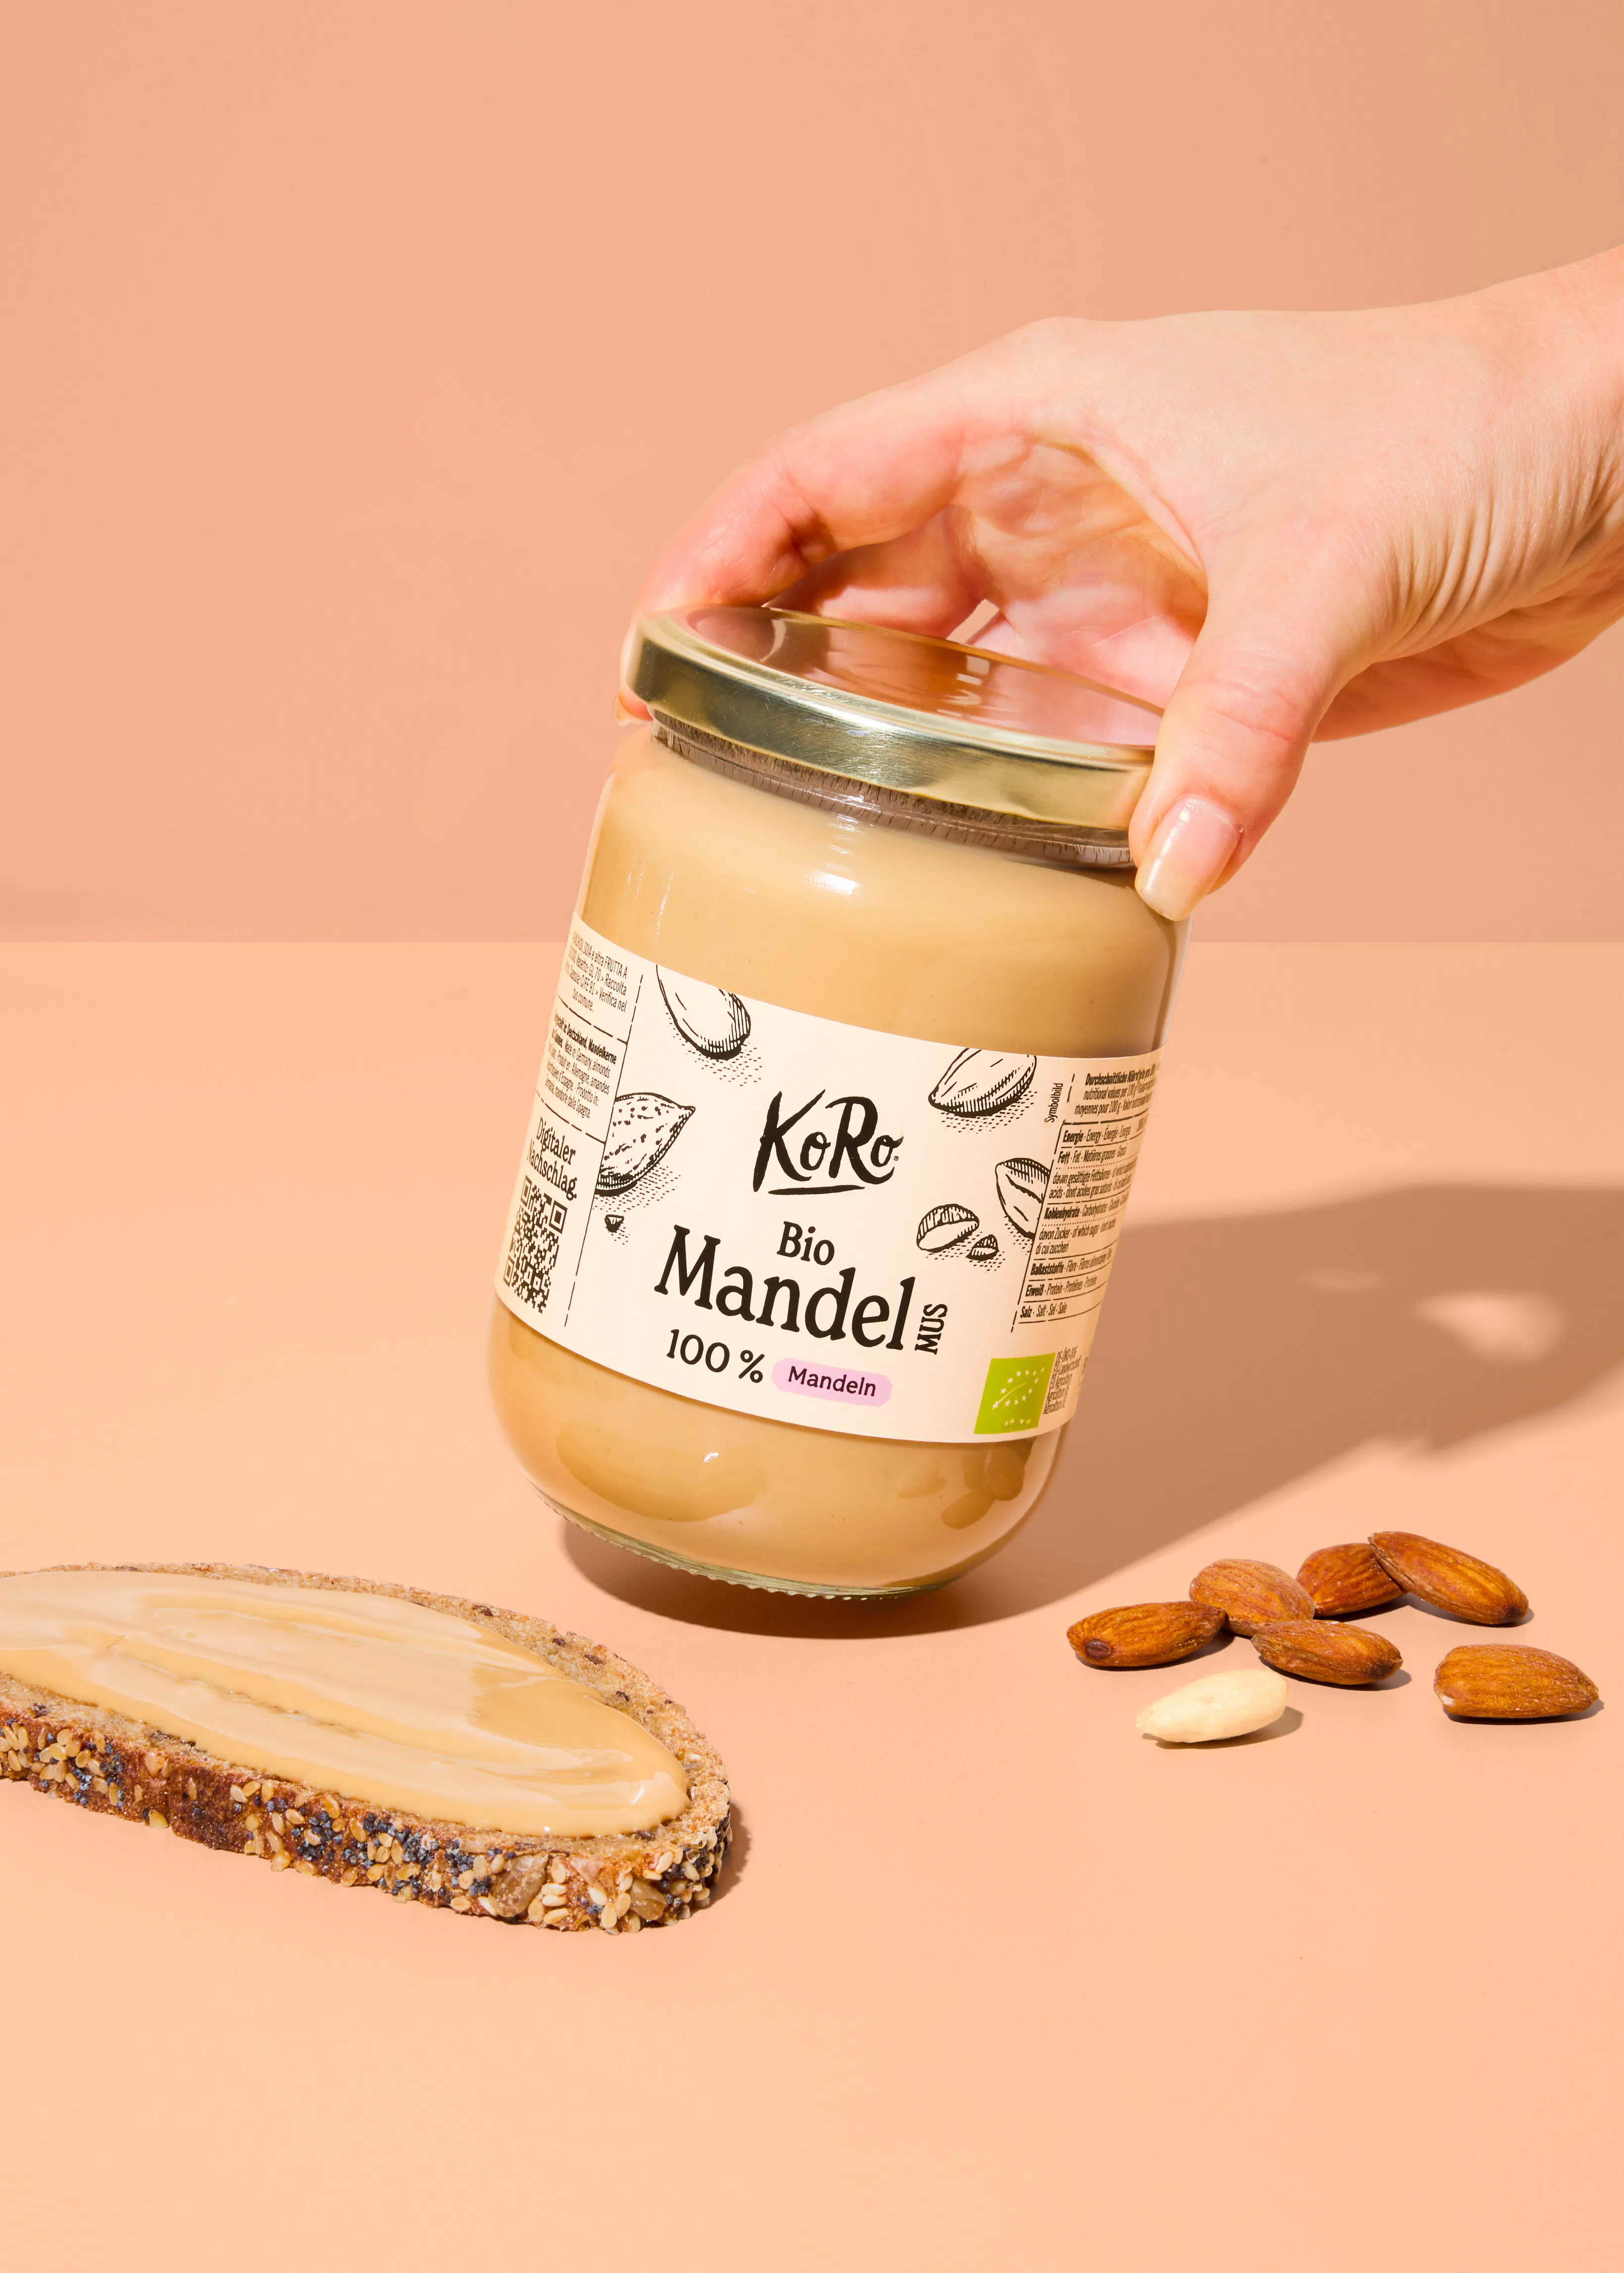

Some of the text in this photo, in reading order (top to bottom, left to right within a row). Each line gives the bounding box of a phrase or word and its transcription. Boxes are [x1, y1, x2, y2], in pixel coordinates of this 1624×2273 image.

[605, 956, 622, 977] FRUTTA
[623, 966, 627, 979] A
[595, 967, 601, 981] 70
[605, 973, 626, 996] Raccolta
[599, 987, 617, 1008] Verifica
[617, 999, 627, 1012] nel
[588, 1038, 616, 1064] Mandelkerne
[592, 1059, 610, 1078] almonds
[576, 1082, 593, 1103] Prodotto
[590, 1077, 610, 1095] amandes
[1083, 1087, 1107, 1100] nutritional
[1107, 1087, 1120, 1099] values
[1044, 1083, 1063, 1122] Symbolbild
[1074, 1104, 1098, 1117] moyennes
[1098, 1104, 1110, 1116] pour
[1109, 1100, 1118, 1113] 100
[536, 1116, 575, 1165] Digitaler
[753, 1089, 904, 1191] KoRo
[1063, 1130, 1084, 1145] Energie
[1086, 1129, 1102, 1144] Energy
[1058, 1151, 1070, 1164] Fett
[1072, 1150, 1081, 1163] Fat
[1083, 1150, 1102, 1162] Matières
[1049, 1186, 1063, 1199] acids
[1066, 1186, 1076, 1198] dont
[1076, 1184, 1090, 1197] acides
[1044, 1206, 1080, 1221] Kohlenhydrate
[777, 1221, 835, 1265] Bio
[1039, 1228, 1055, 1240] davon
[1055, 1227, 1070, 1239] Zucker
[1035, 1240, 1069, 1255] di cui zuccheri
[1030, 1262, 1064, 1275] Ballaststoffe
[654, 1224, 915, 1350] Mandel
[1025, 1284, 1045, 1296] Eiweiß
[1047, 1282, 1063, 1295] Protein
[1020, 1302, 1067, 1318] Salz Salt Sel Sale
[914, 1303, 948, 1354] MUS
[666, 1329, 876, 1396] 100 % Mandeln
